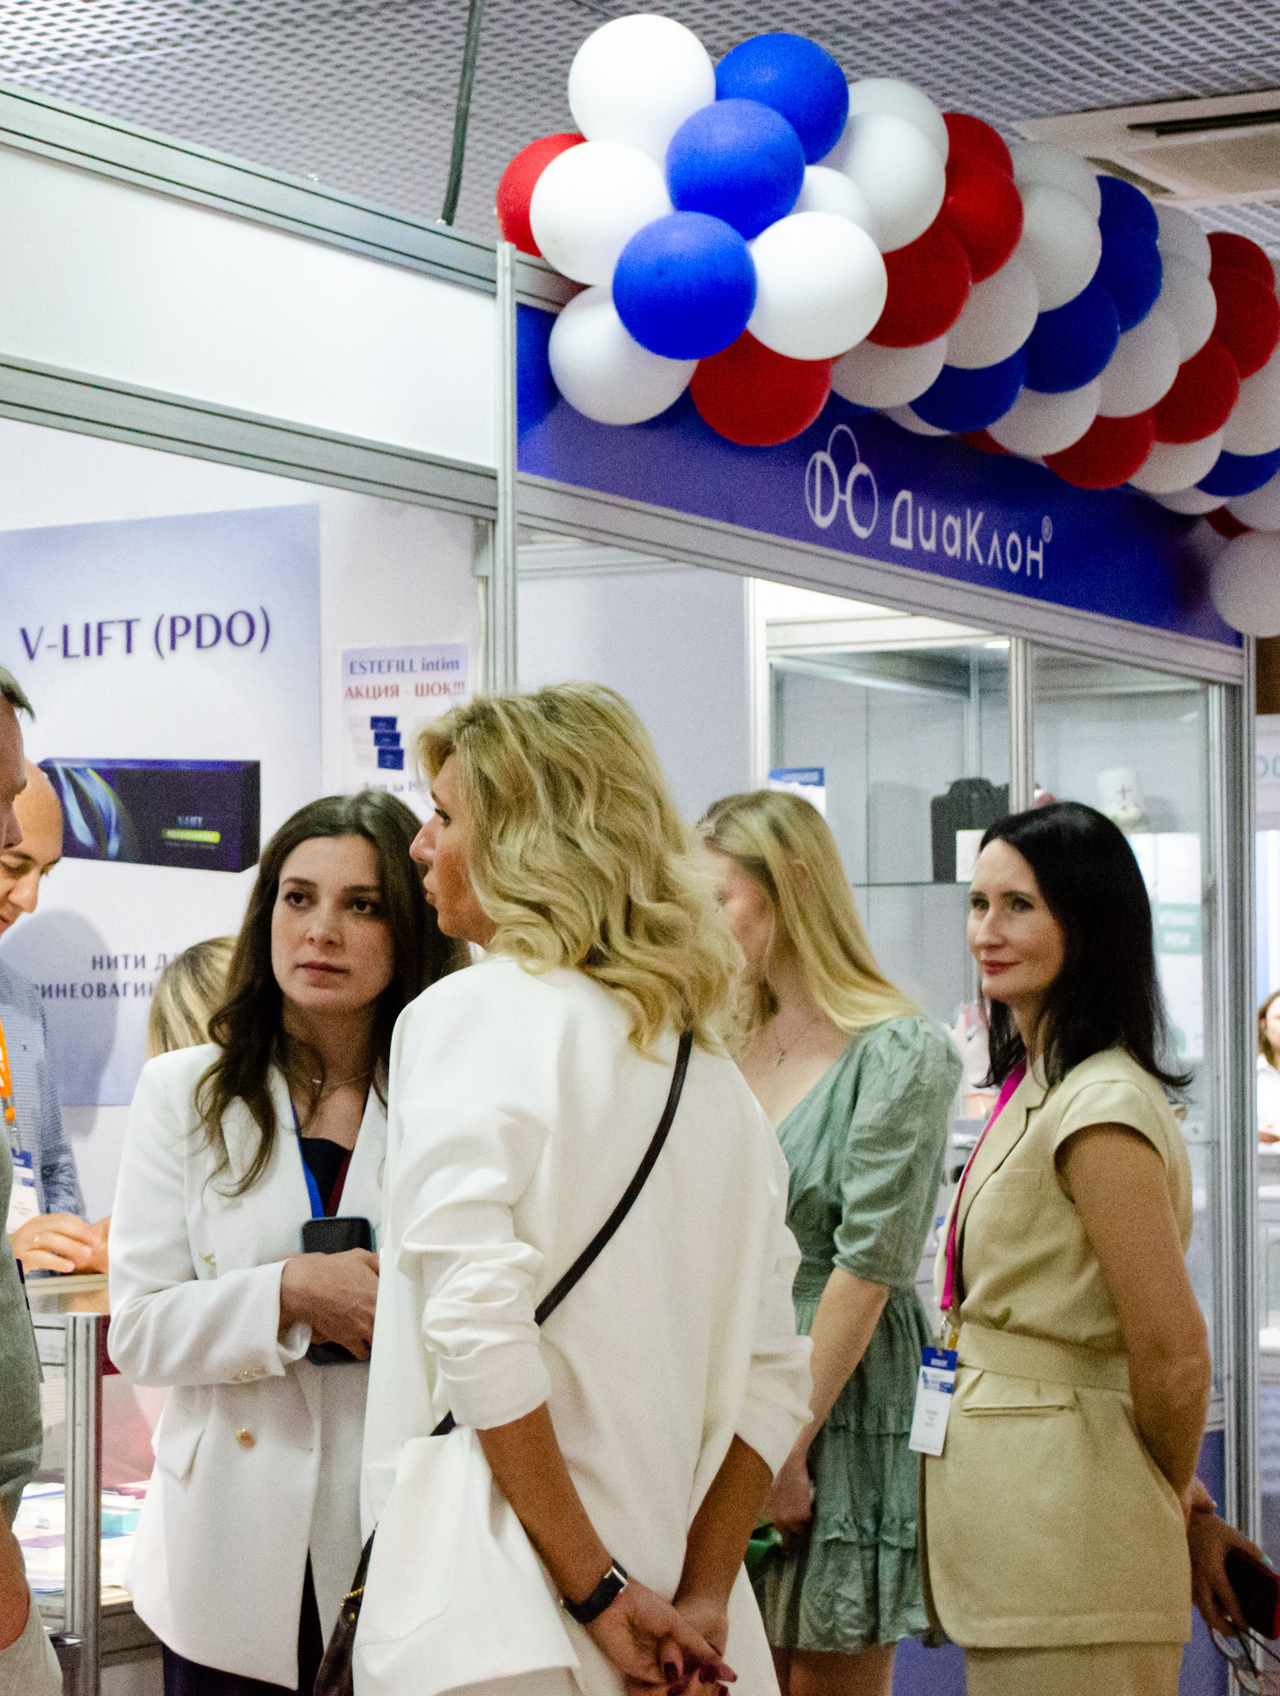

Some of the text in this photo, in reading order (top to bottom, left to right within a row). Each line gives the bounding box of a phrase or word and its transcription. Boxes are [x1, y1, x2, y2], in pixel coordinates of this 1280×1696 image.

[20, 606, 271, 661] V-LIFT (PDO)
[348, 656, 460, 676] ESTEFILL intim
[344, 683, 400, 700] АКЦИЯ
[414, 681, 465, 698] ШОК!!!
[91, 954, 146, 970] НИТИ
